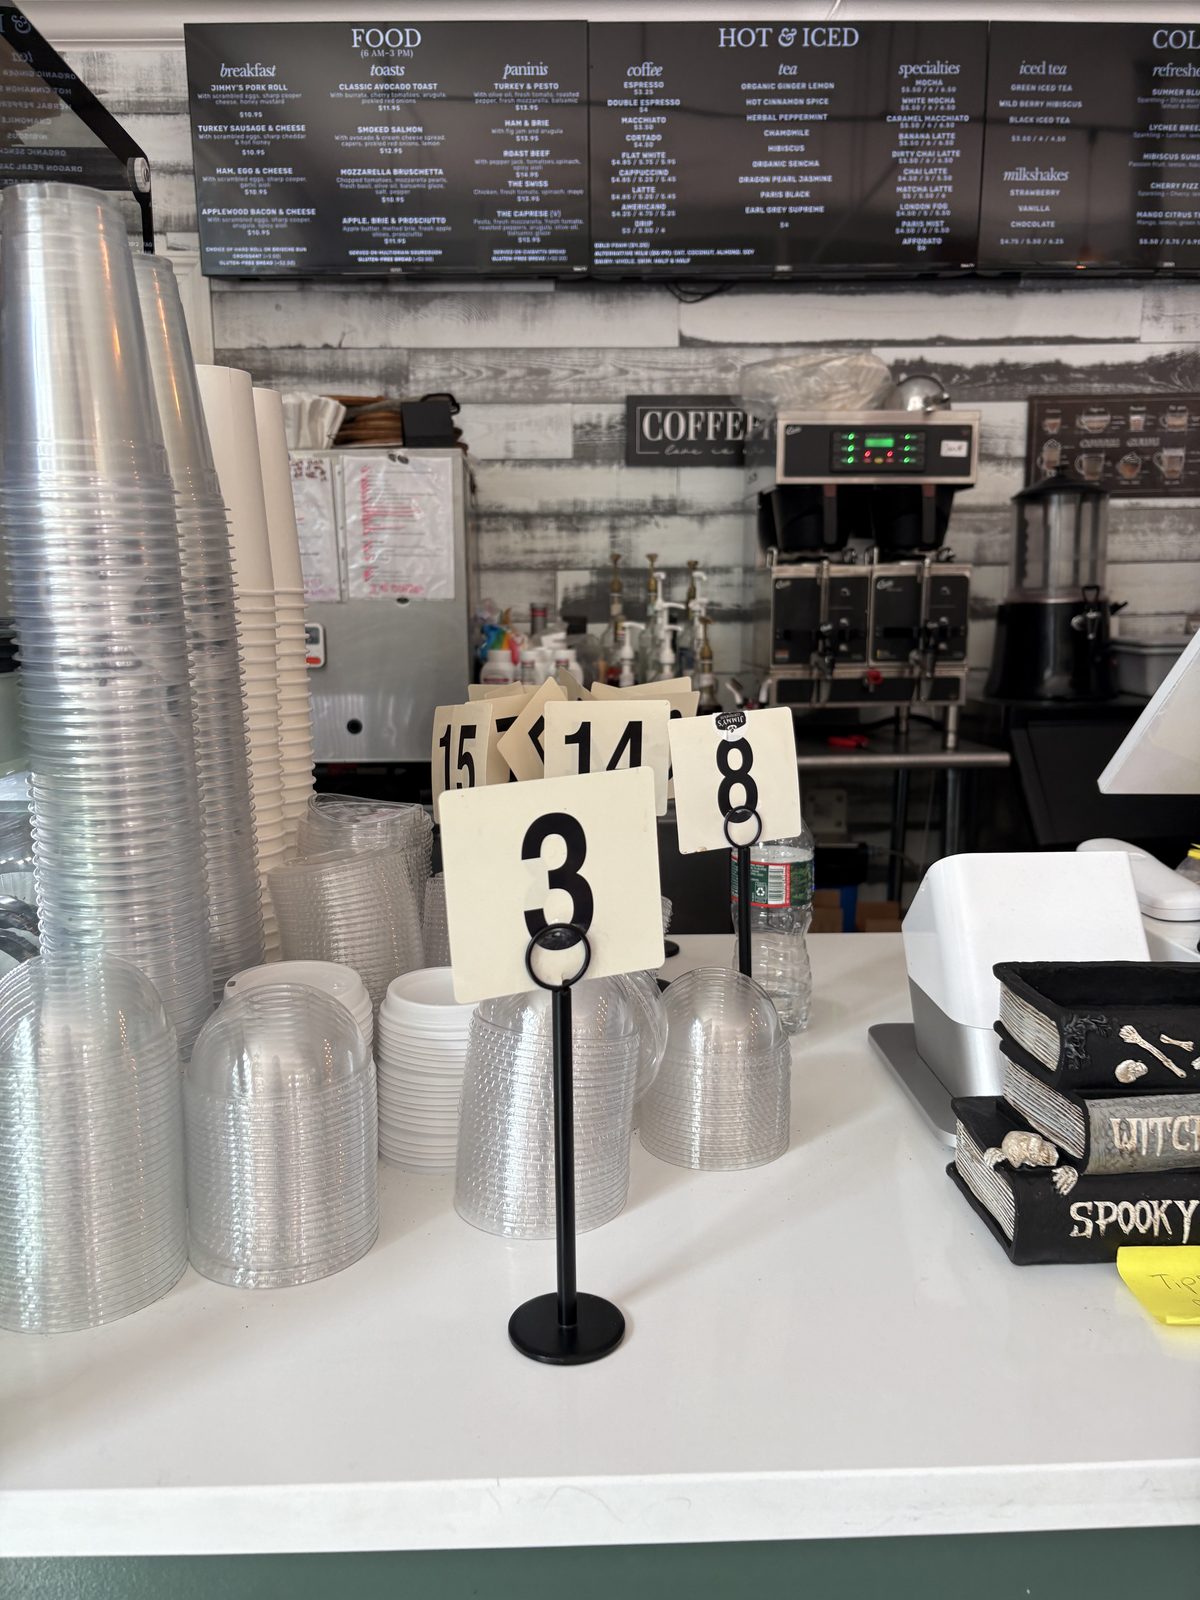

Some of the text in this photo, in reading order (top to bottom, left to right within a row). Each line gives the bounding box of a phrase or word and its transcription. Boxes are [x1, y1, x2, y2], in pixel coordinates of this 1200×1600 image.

[351, 28, 422, 48] FOOD
[718, 27, 859, 47] HOT & ICED
[1152, 29, 1200, 49] COL
[361, 49, 369, 59] (6
[397, 49, 414, 59] PM)
[220, 63, 276, 78] breakfast
[370, 64, 405, 76] toasts
[502, 61, 549, 80] paninis
[627, 61, 663, 77] coffee
[778, 64, 798, 75] tea
[898, 60, 961, 79] specialties
[1019, 60, 1068, 75] iced tea
[1010, 83, 1073, 91] GREEN ICED TEA
[1152, 88, 1184, 96] SUMMER
[607, 99, 639, 107] DOUBLE
[746, 98, 762, 106] HOT
[999, 100, 1083, 108] WILD BERRY HIBISCUS
[778, 113, 828, 121] PEPPERMINT
[1009, 116, 1071, 124] BLACK ICED TEA
[625, 134, 662, 142] CORTADO
[763, 129, 810, 137] CHAMOMILE
[752, 160, 787, 168] ORGANIC
[1003, 166, 1070, 181] milkshakes
[507, 180, 549, 188] THE SWISS
[896, 185, 953, 193] MATCHA LATTE
[621, 203, 667, 211] AMERICANO
[745, 206, 765, 214] EARL
[766, 206, 787, 214] GREY
[496, 210, 512, 218] THE
[717, 716, 743, 727] JIMMY'S
[565, 721, 643, 775] 14
[439, 724, 477, 790] 15
[716, 738, 759, 823] 8
[521, 812, 594, 950] 3
[1069, 1199, 1200, 1244] SPOOKY
